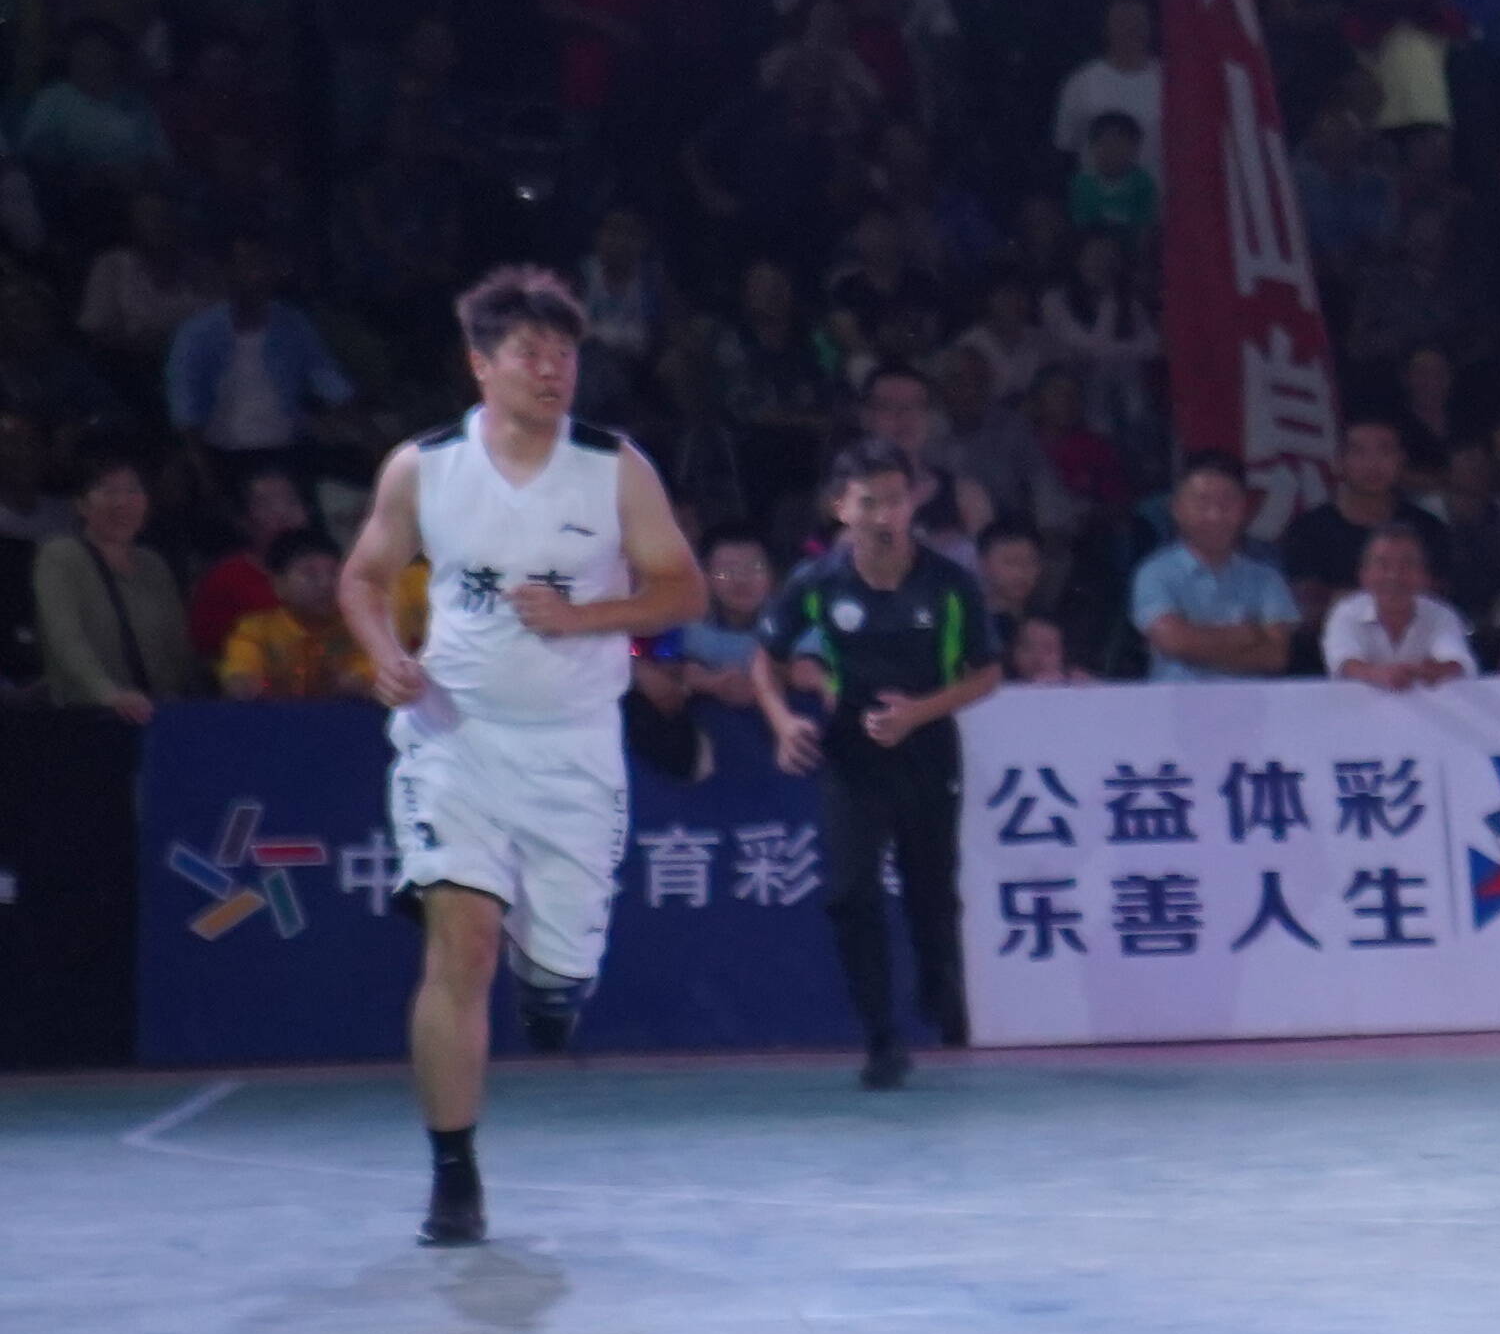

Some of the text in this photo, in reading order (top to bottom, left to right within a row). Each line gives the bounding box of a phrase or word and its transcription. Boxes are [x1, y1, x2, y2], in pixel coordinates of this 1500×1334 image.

[985, 759, 1427, 848] 公益体彩
[996, 868, 1438, 960] 乐善人生
